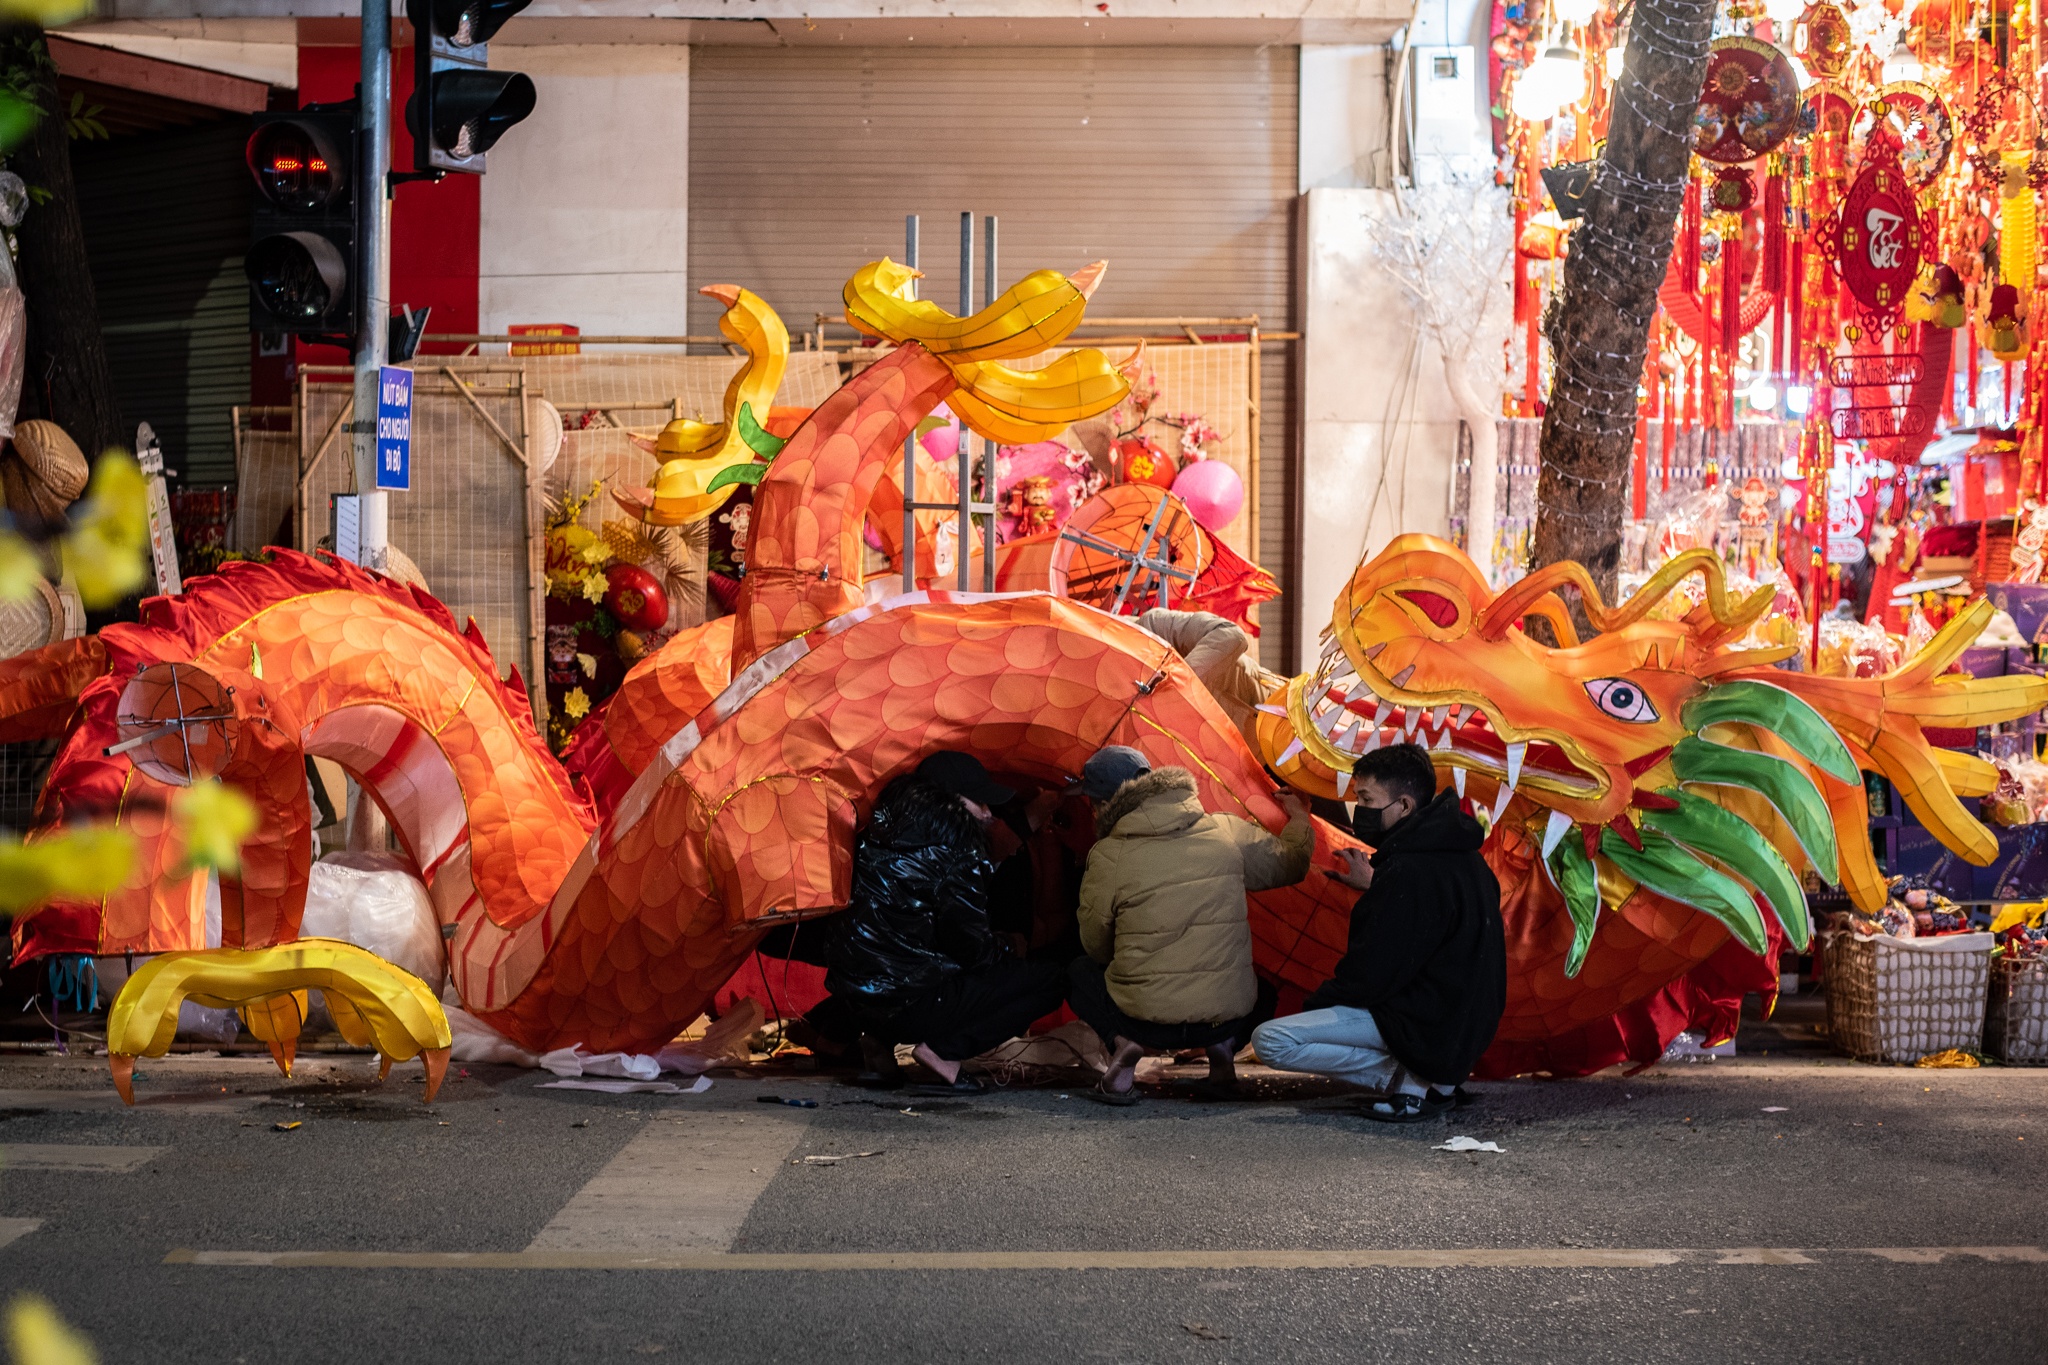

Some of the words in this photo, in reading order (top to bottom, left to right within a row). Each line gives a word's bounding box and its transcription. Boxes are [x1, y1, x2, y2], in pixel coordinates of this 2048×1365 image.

[1867, 208, 1904, 269] Tết
[383, 378, 395, 406] NÚT
[380, 417, 391, 439] CHO
